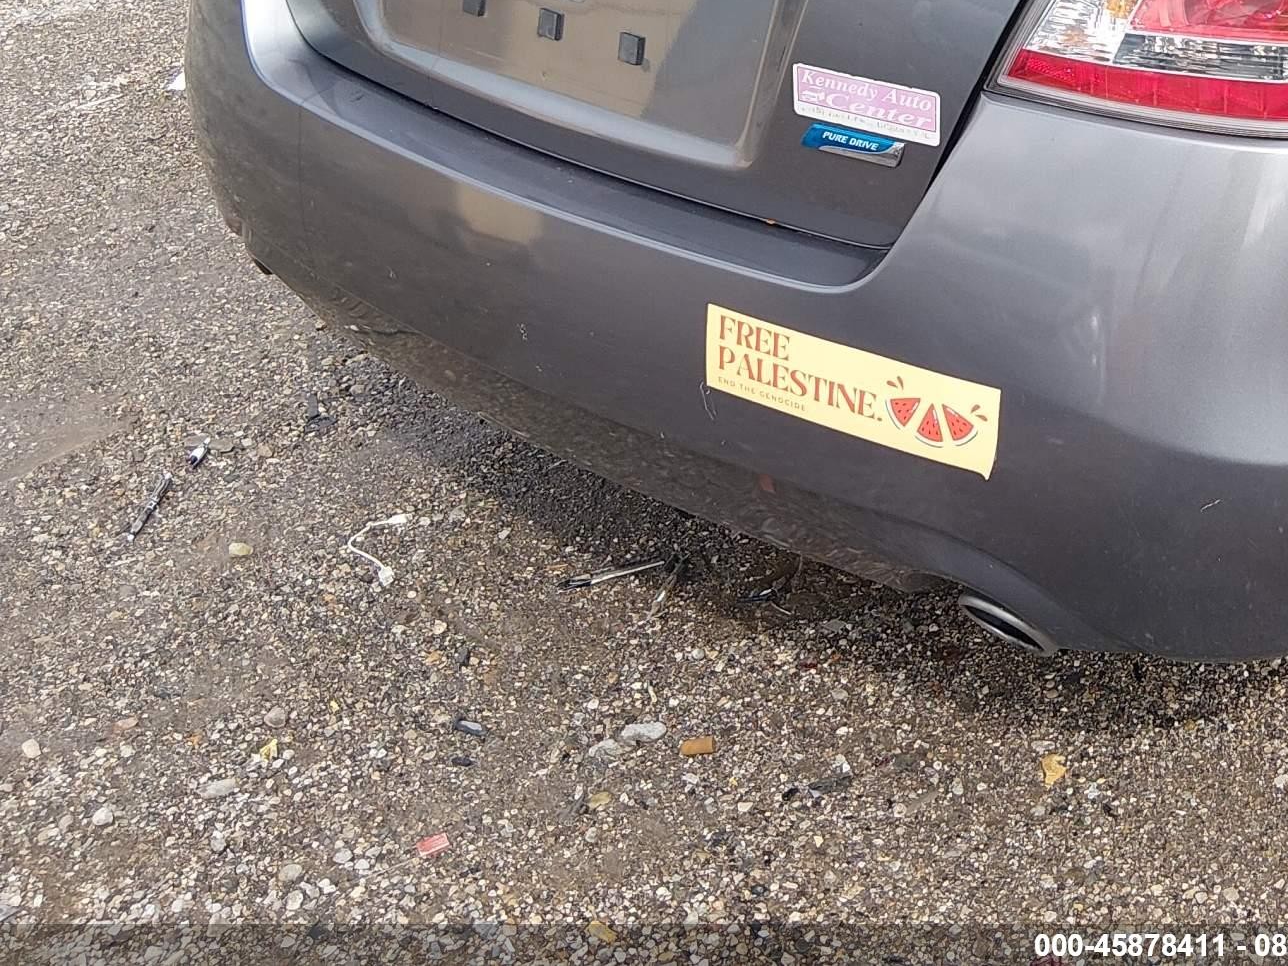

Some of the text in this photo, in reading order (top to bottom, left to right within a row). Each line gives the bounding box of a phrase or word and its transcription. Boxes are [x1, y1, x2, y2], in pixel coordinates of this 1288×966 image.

[801, 69, 932, 111] Kennedy Auto
[826, 93, 932, 128] Center
[822, 131, 879, 151] PURE DRIVE
[719, 315, 790, 361] FREE
[718, 345, 883, 422] PALESTINE.
[718, 376, 806, 412] END THE GENOCIDE
